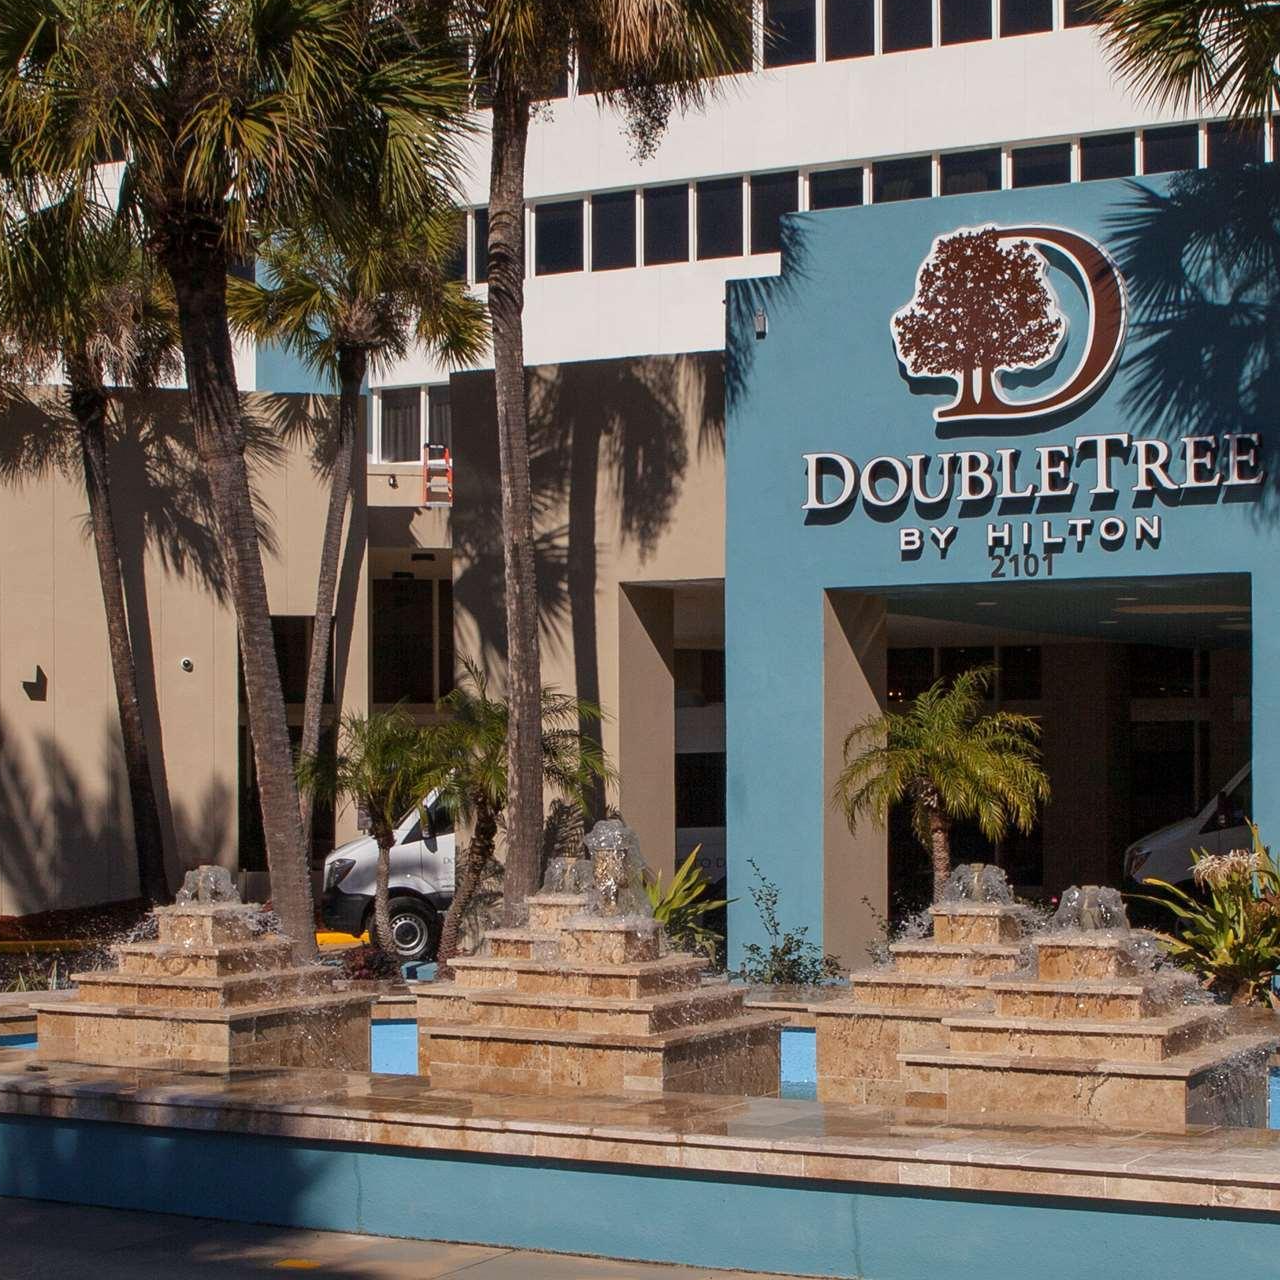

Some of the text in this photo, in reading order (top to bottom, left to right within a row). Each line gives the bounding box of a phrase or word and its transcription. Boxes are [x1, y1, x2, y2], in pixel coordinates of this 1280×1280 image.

[801, 432, 1264, 510] DOUBLETREE
[900, 516, 1160, 551] BY HILTON
[991, 552, 1054, 578] 2101
